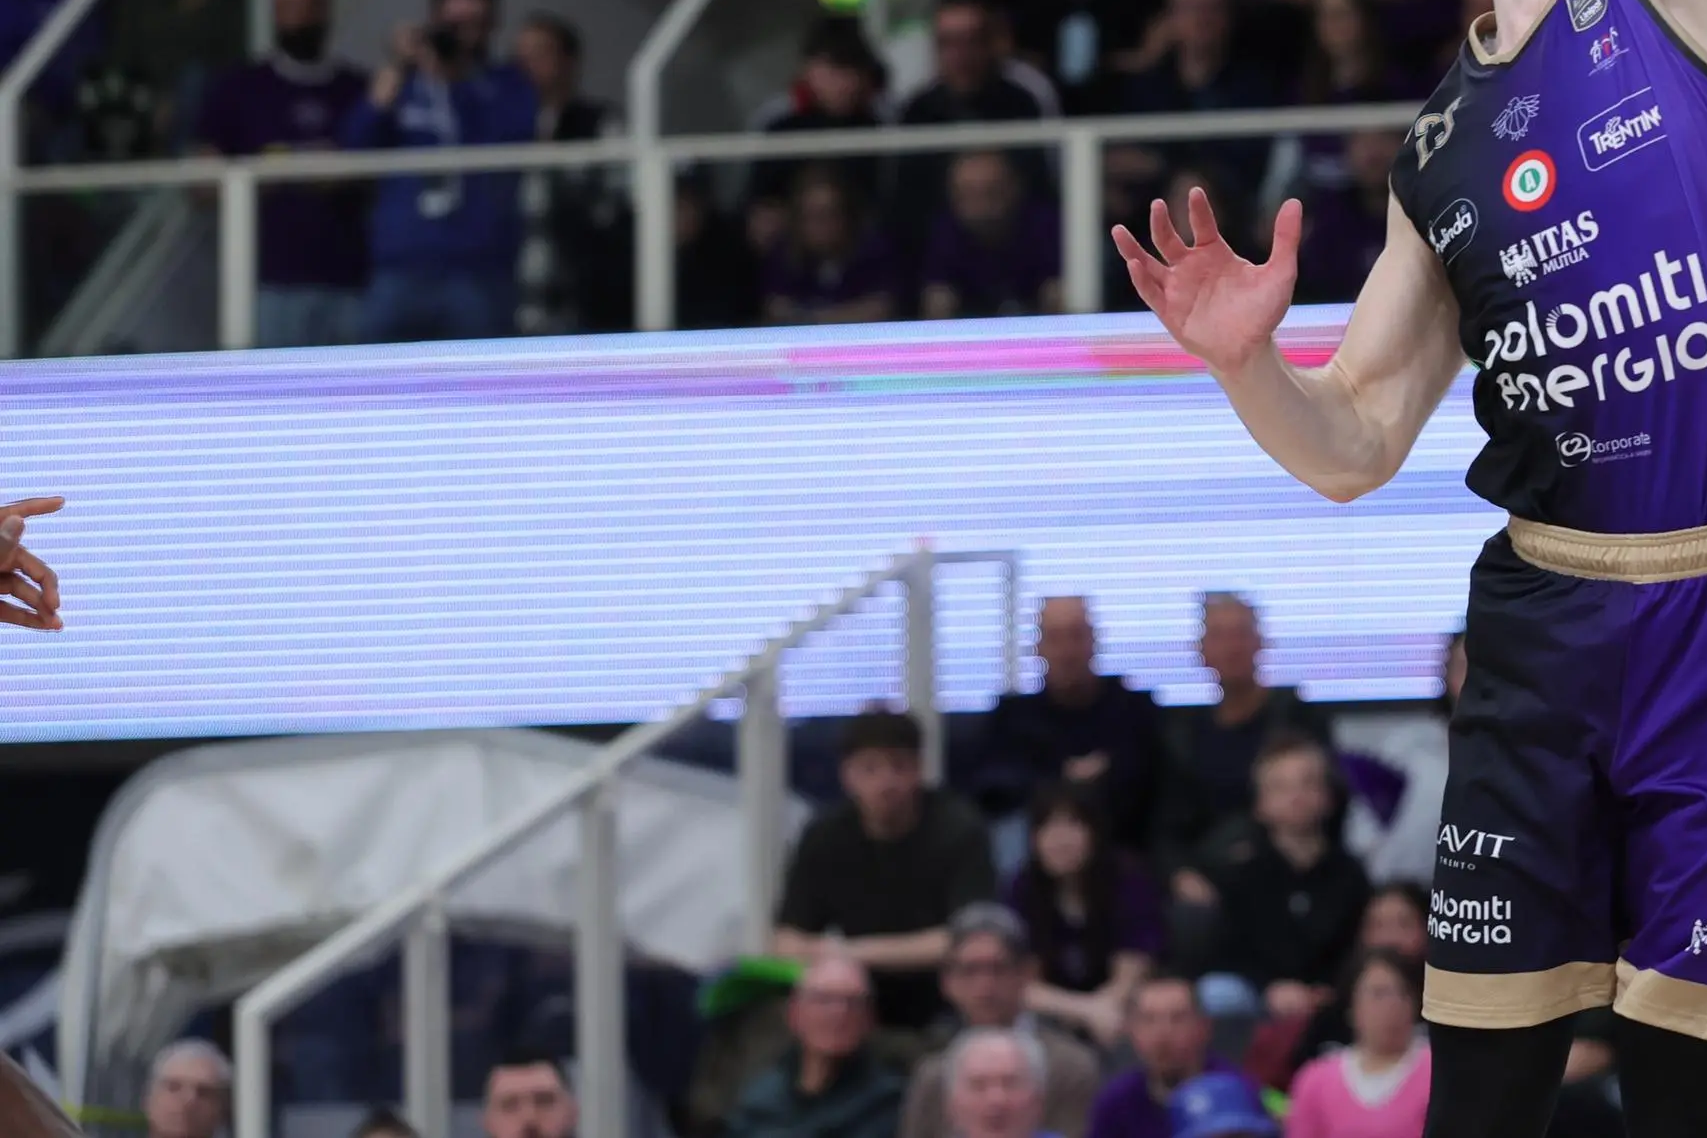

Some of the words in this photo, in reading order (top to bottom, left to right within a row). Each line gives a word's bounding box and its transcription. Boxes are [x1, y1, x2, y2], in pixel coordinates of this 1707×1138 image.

[1531, 209, 1600, 263] ITAS
[1542, 247, 1590, 275] MUTUA
[1437, 820, 1516, 859] AVIT
